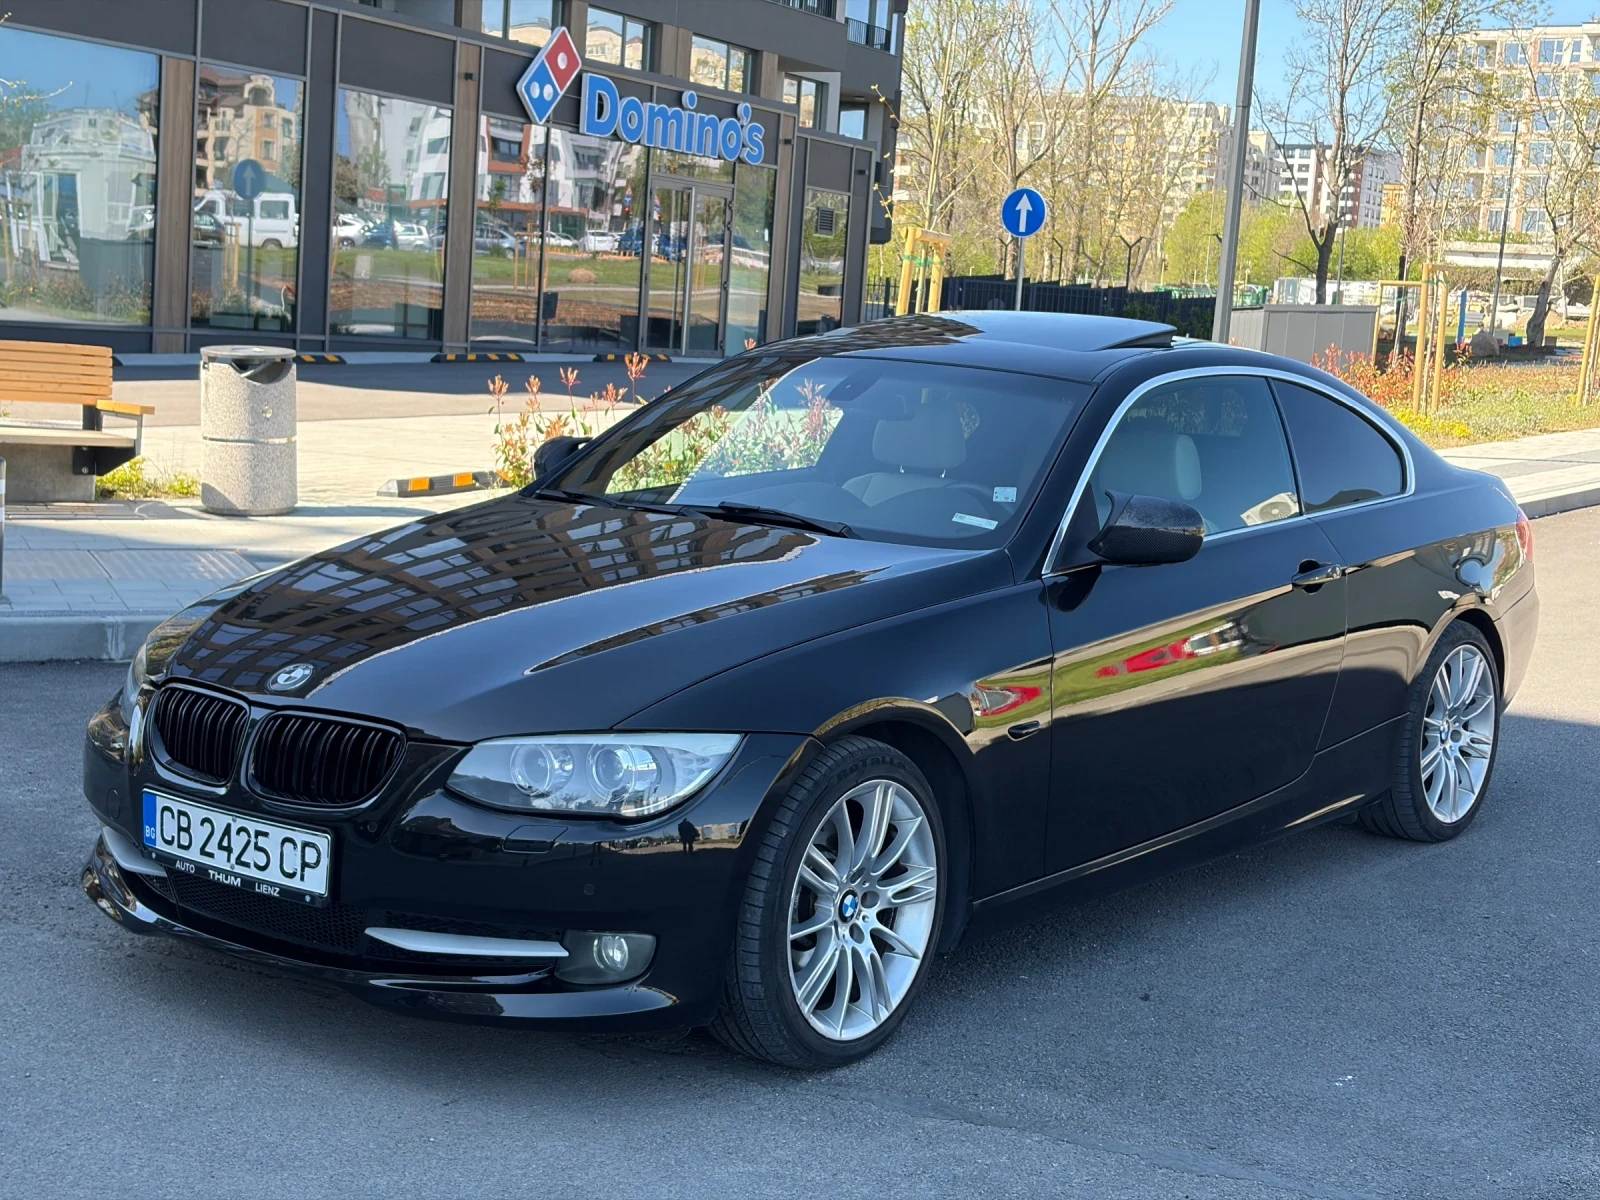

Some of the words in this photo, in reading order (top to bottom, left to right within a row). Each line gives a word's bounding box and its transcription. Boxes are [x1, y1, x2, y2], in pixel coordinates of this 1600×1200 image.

[580, 72, 765, 165] Domino's
[145, 826, 156, 839] BG
[160, 805, 193, 851] CB
[199, 816, 271, 872] 2425
[279, 836, 322, 882] CP
[175, 859, 196, 874] AUTO
[208, 869, 241, 888] THUM
[255, 882, 280, 897] LIENZ
